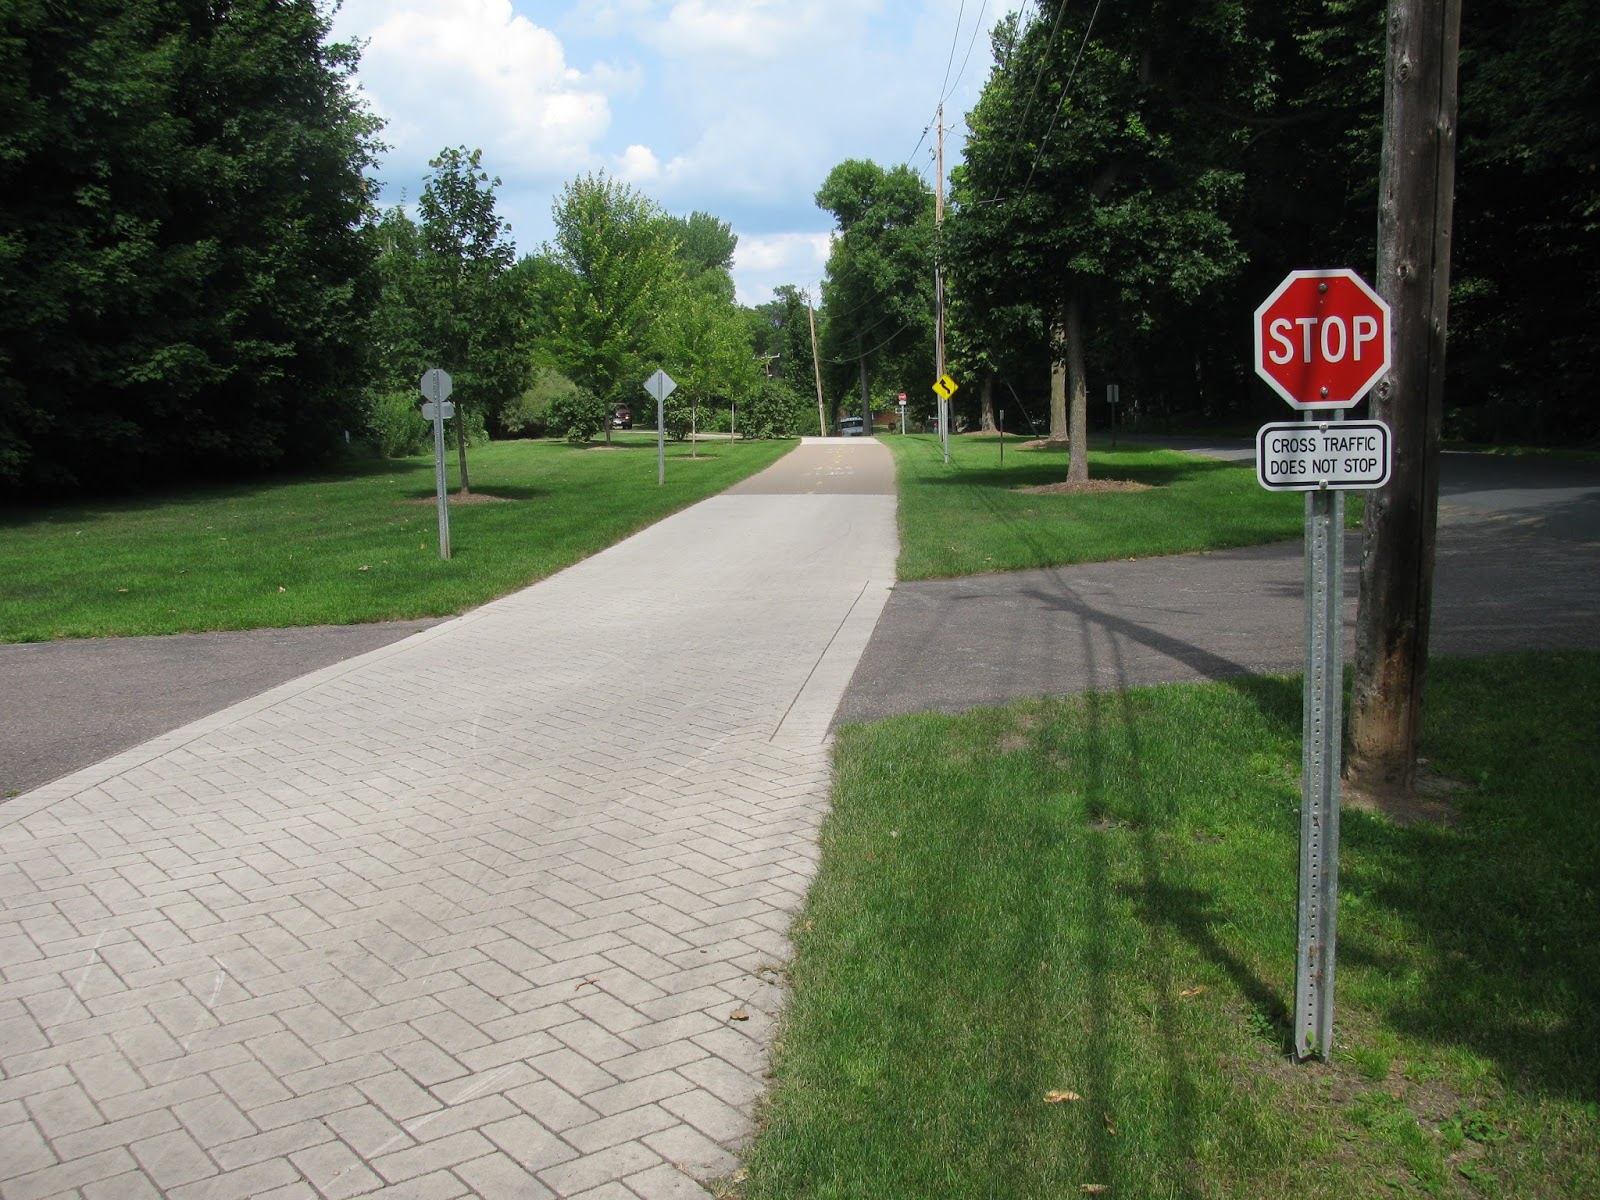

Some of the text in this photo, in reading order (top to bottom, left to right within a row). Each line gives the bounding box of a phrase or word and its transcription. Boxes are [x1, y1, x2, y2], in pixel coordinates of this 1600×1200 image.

[1268, 315, 1378, 365] STOP
[1272, 437, 1376, 453] CROSS TRAFFIC
[1270, 458, 1377, 475] DOES NOT STOP
